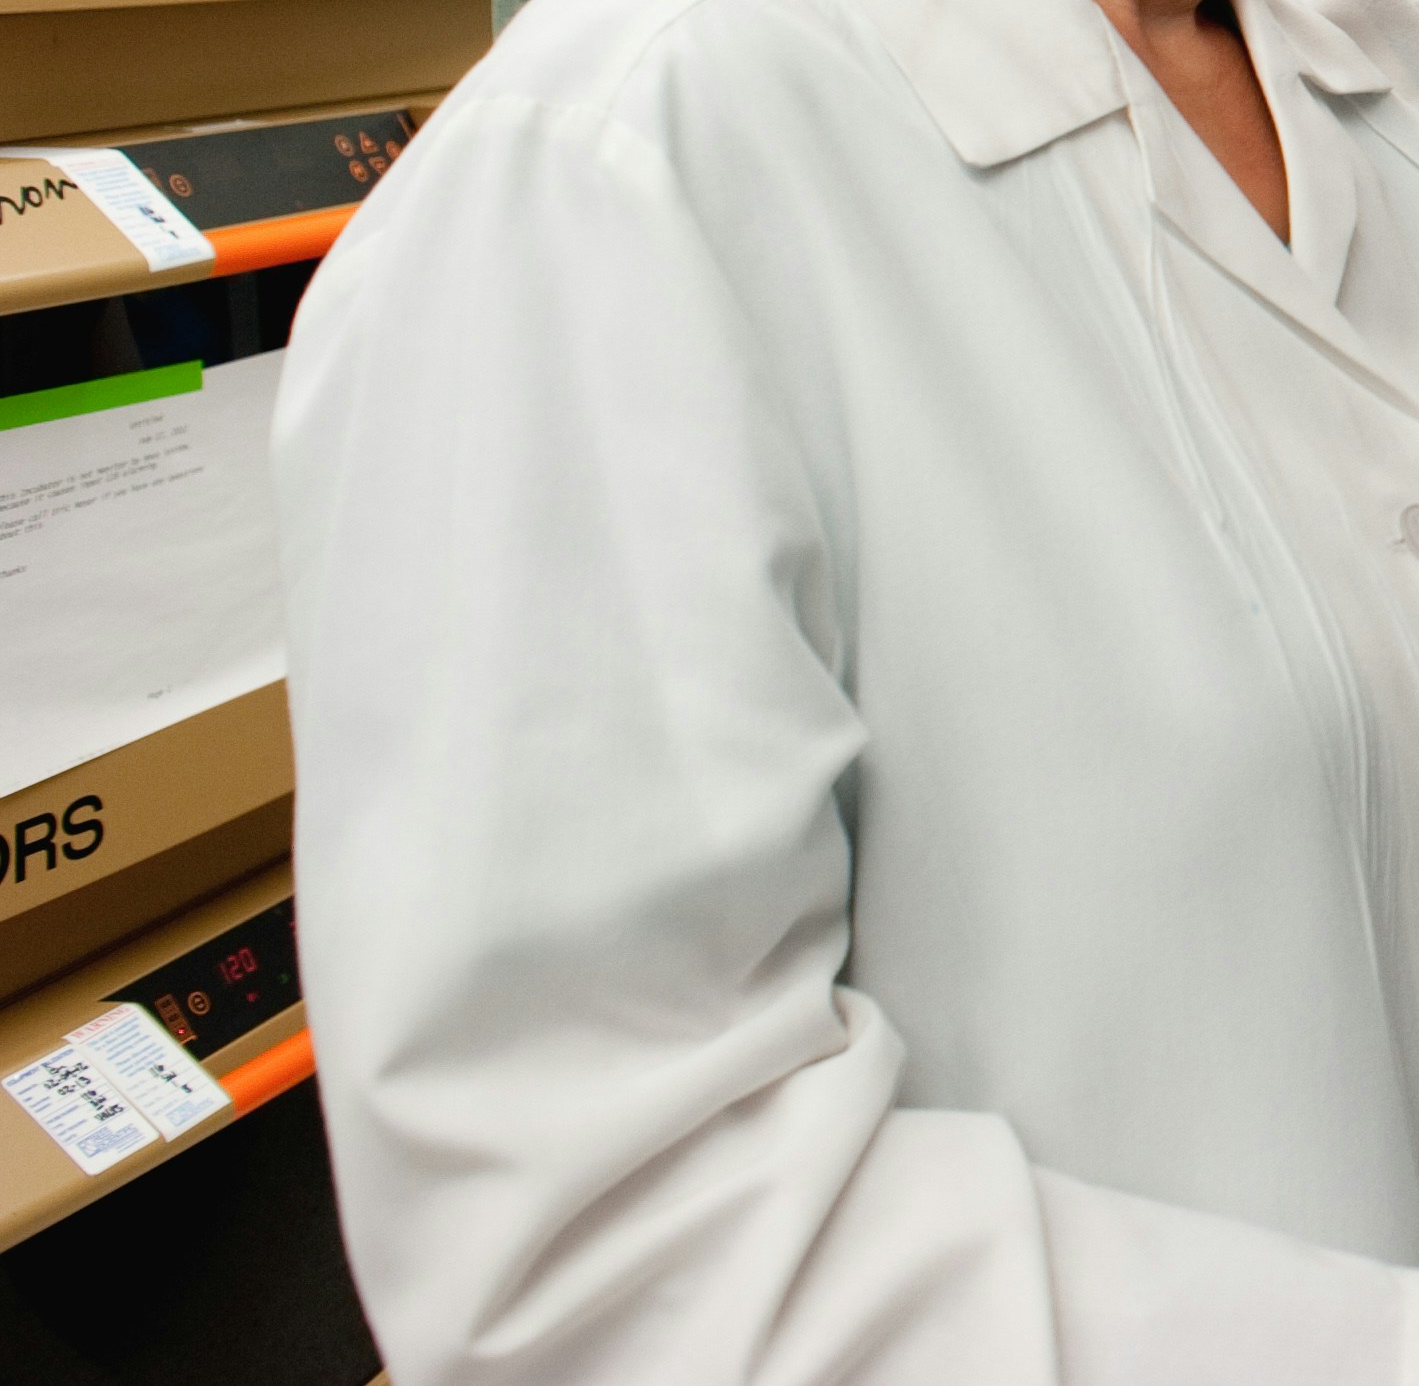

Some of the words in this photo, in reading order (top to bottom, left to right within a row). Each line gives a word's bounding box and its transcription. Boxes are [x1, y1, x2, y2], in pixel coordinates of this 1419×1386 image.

[0, 795, 104, 885] RS
[218, 946, 257, 983] 120
[70, 1006, 135, 1040] WARNING
